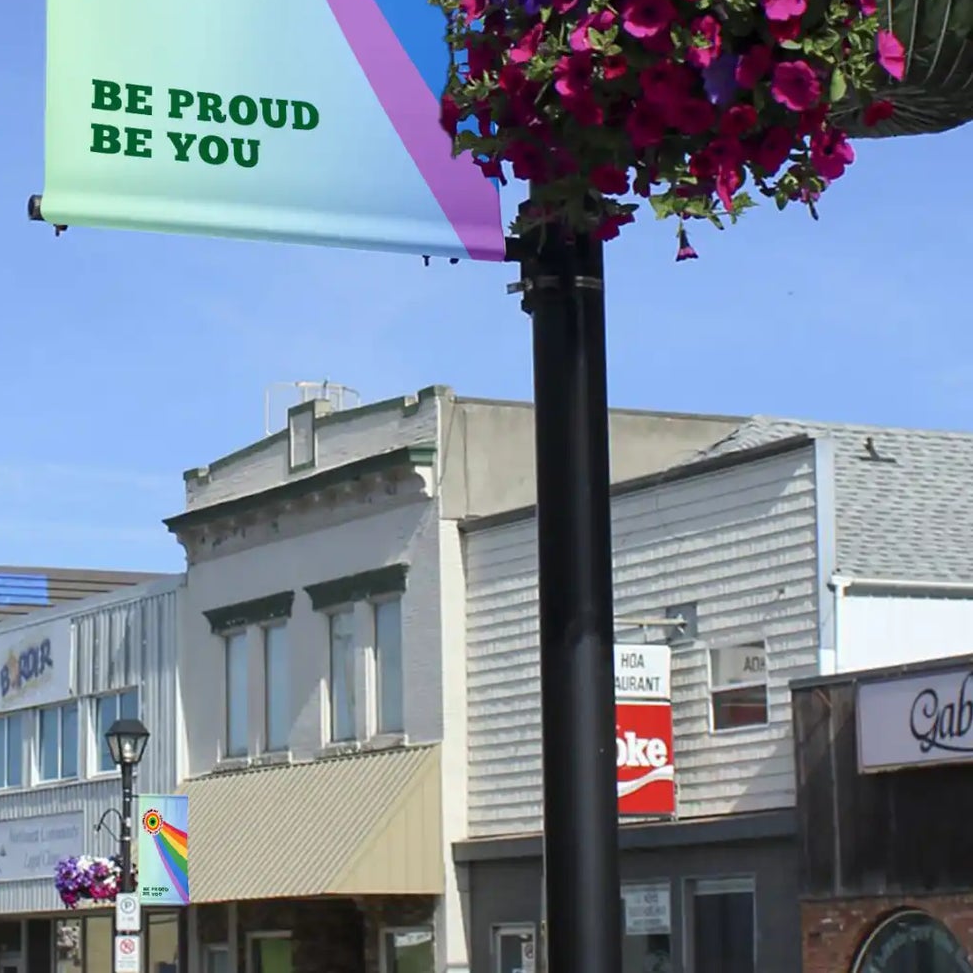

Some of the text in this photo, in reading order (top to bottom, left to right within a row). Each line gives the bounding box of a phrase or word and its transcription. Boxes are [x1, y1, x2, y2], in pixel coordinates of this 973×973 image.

[91, 79, 320, 131] BE PROUD
[90, 123, 261, 168] BE YOU
[621, 653, 645, 668] HOA
